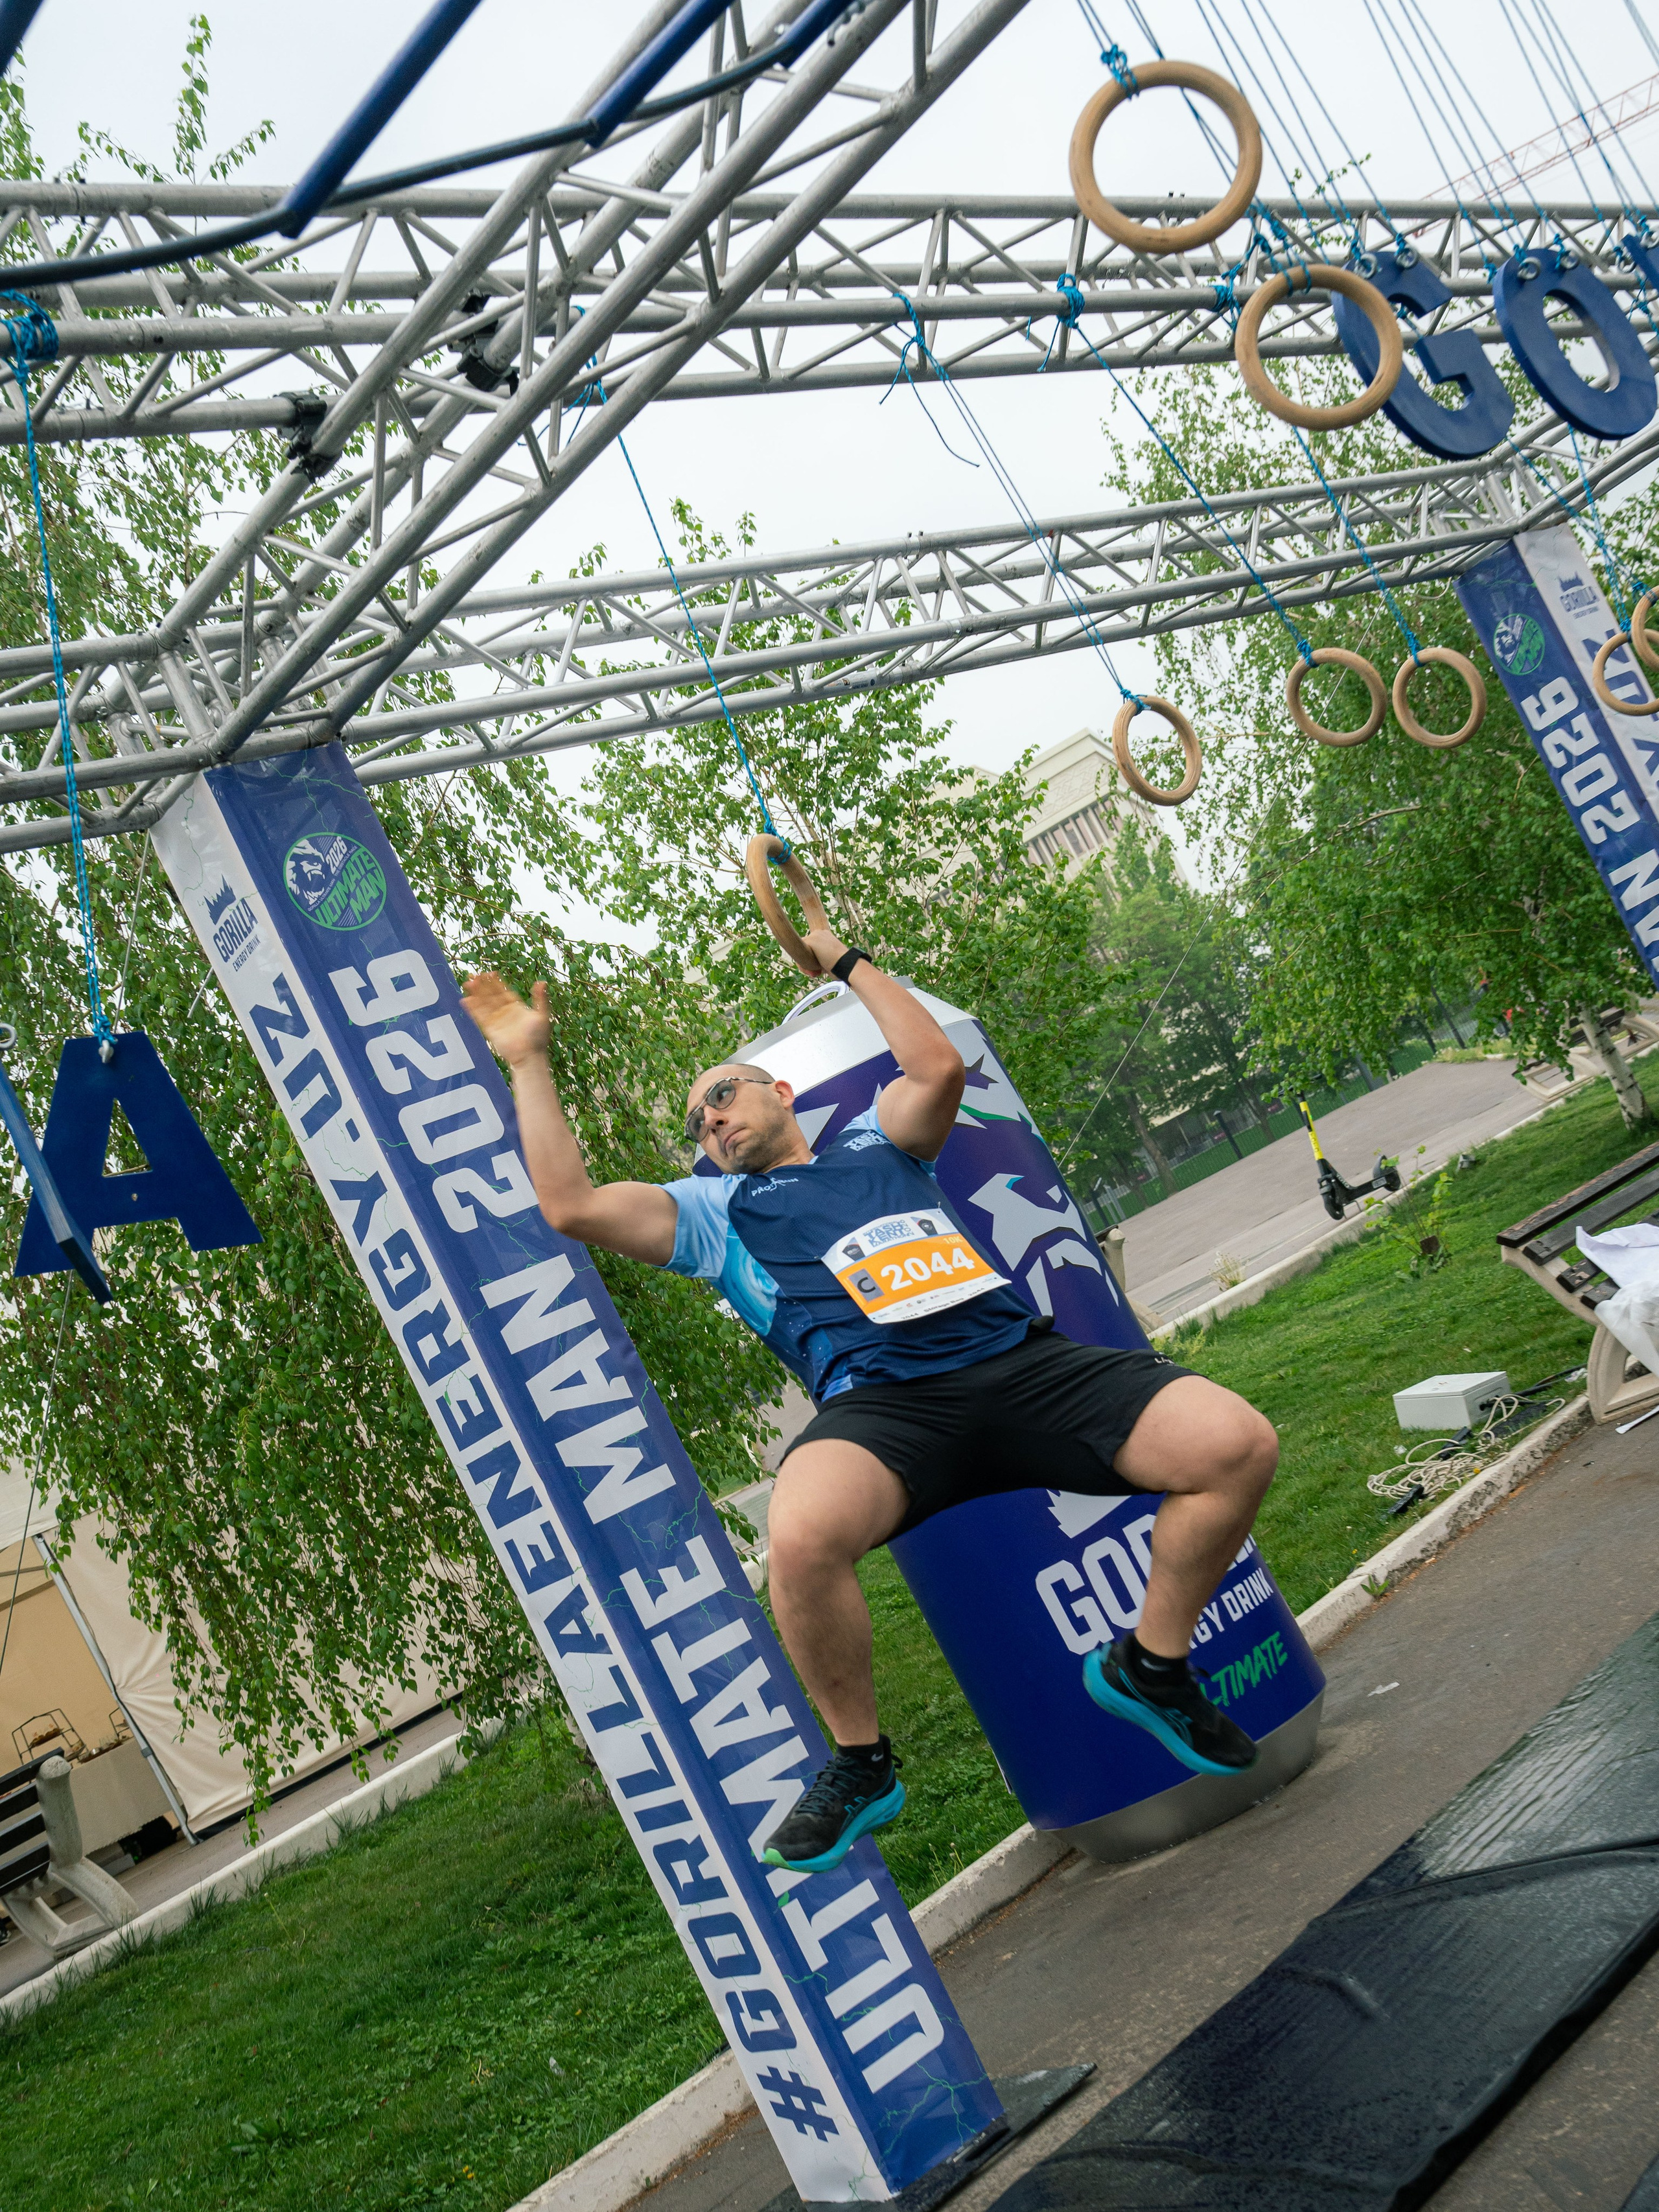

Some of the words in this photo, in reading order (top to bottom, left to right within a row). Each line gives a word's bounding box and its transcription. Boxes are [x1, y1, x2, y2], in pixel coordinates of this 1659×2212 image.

[1520, 676, 1640, 844] 2026
[326, 836, 347, 874] 2026
[315, 847, 376, 927] ULTIMATE
[349, 868, 385, 924] MAN
[213, 898, 259, 963] GORILLA
[233, 950, 249, 972] ENERGY
[247, 934, 261, 955] DRINK
[328, 949, 540, 1233] 2026
[944, 1235, 963, 1245] 10K
[857, 1277, 876, 1293] C
[881, 1248, 975, 1291] 2044
[923, 1302, 951, 1313] Storage
[480, 1253, 676, 1524] MAN
[1220, 1567, 1274, 1622] DRINK
[1199, 1631, 1288, 1707] LTIMATE
